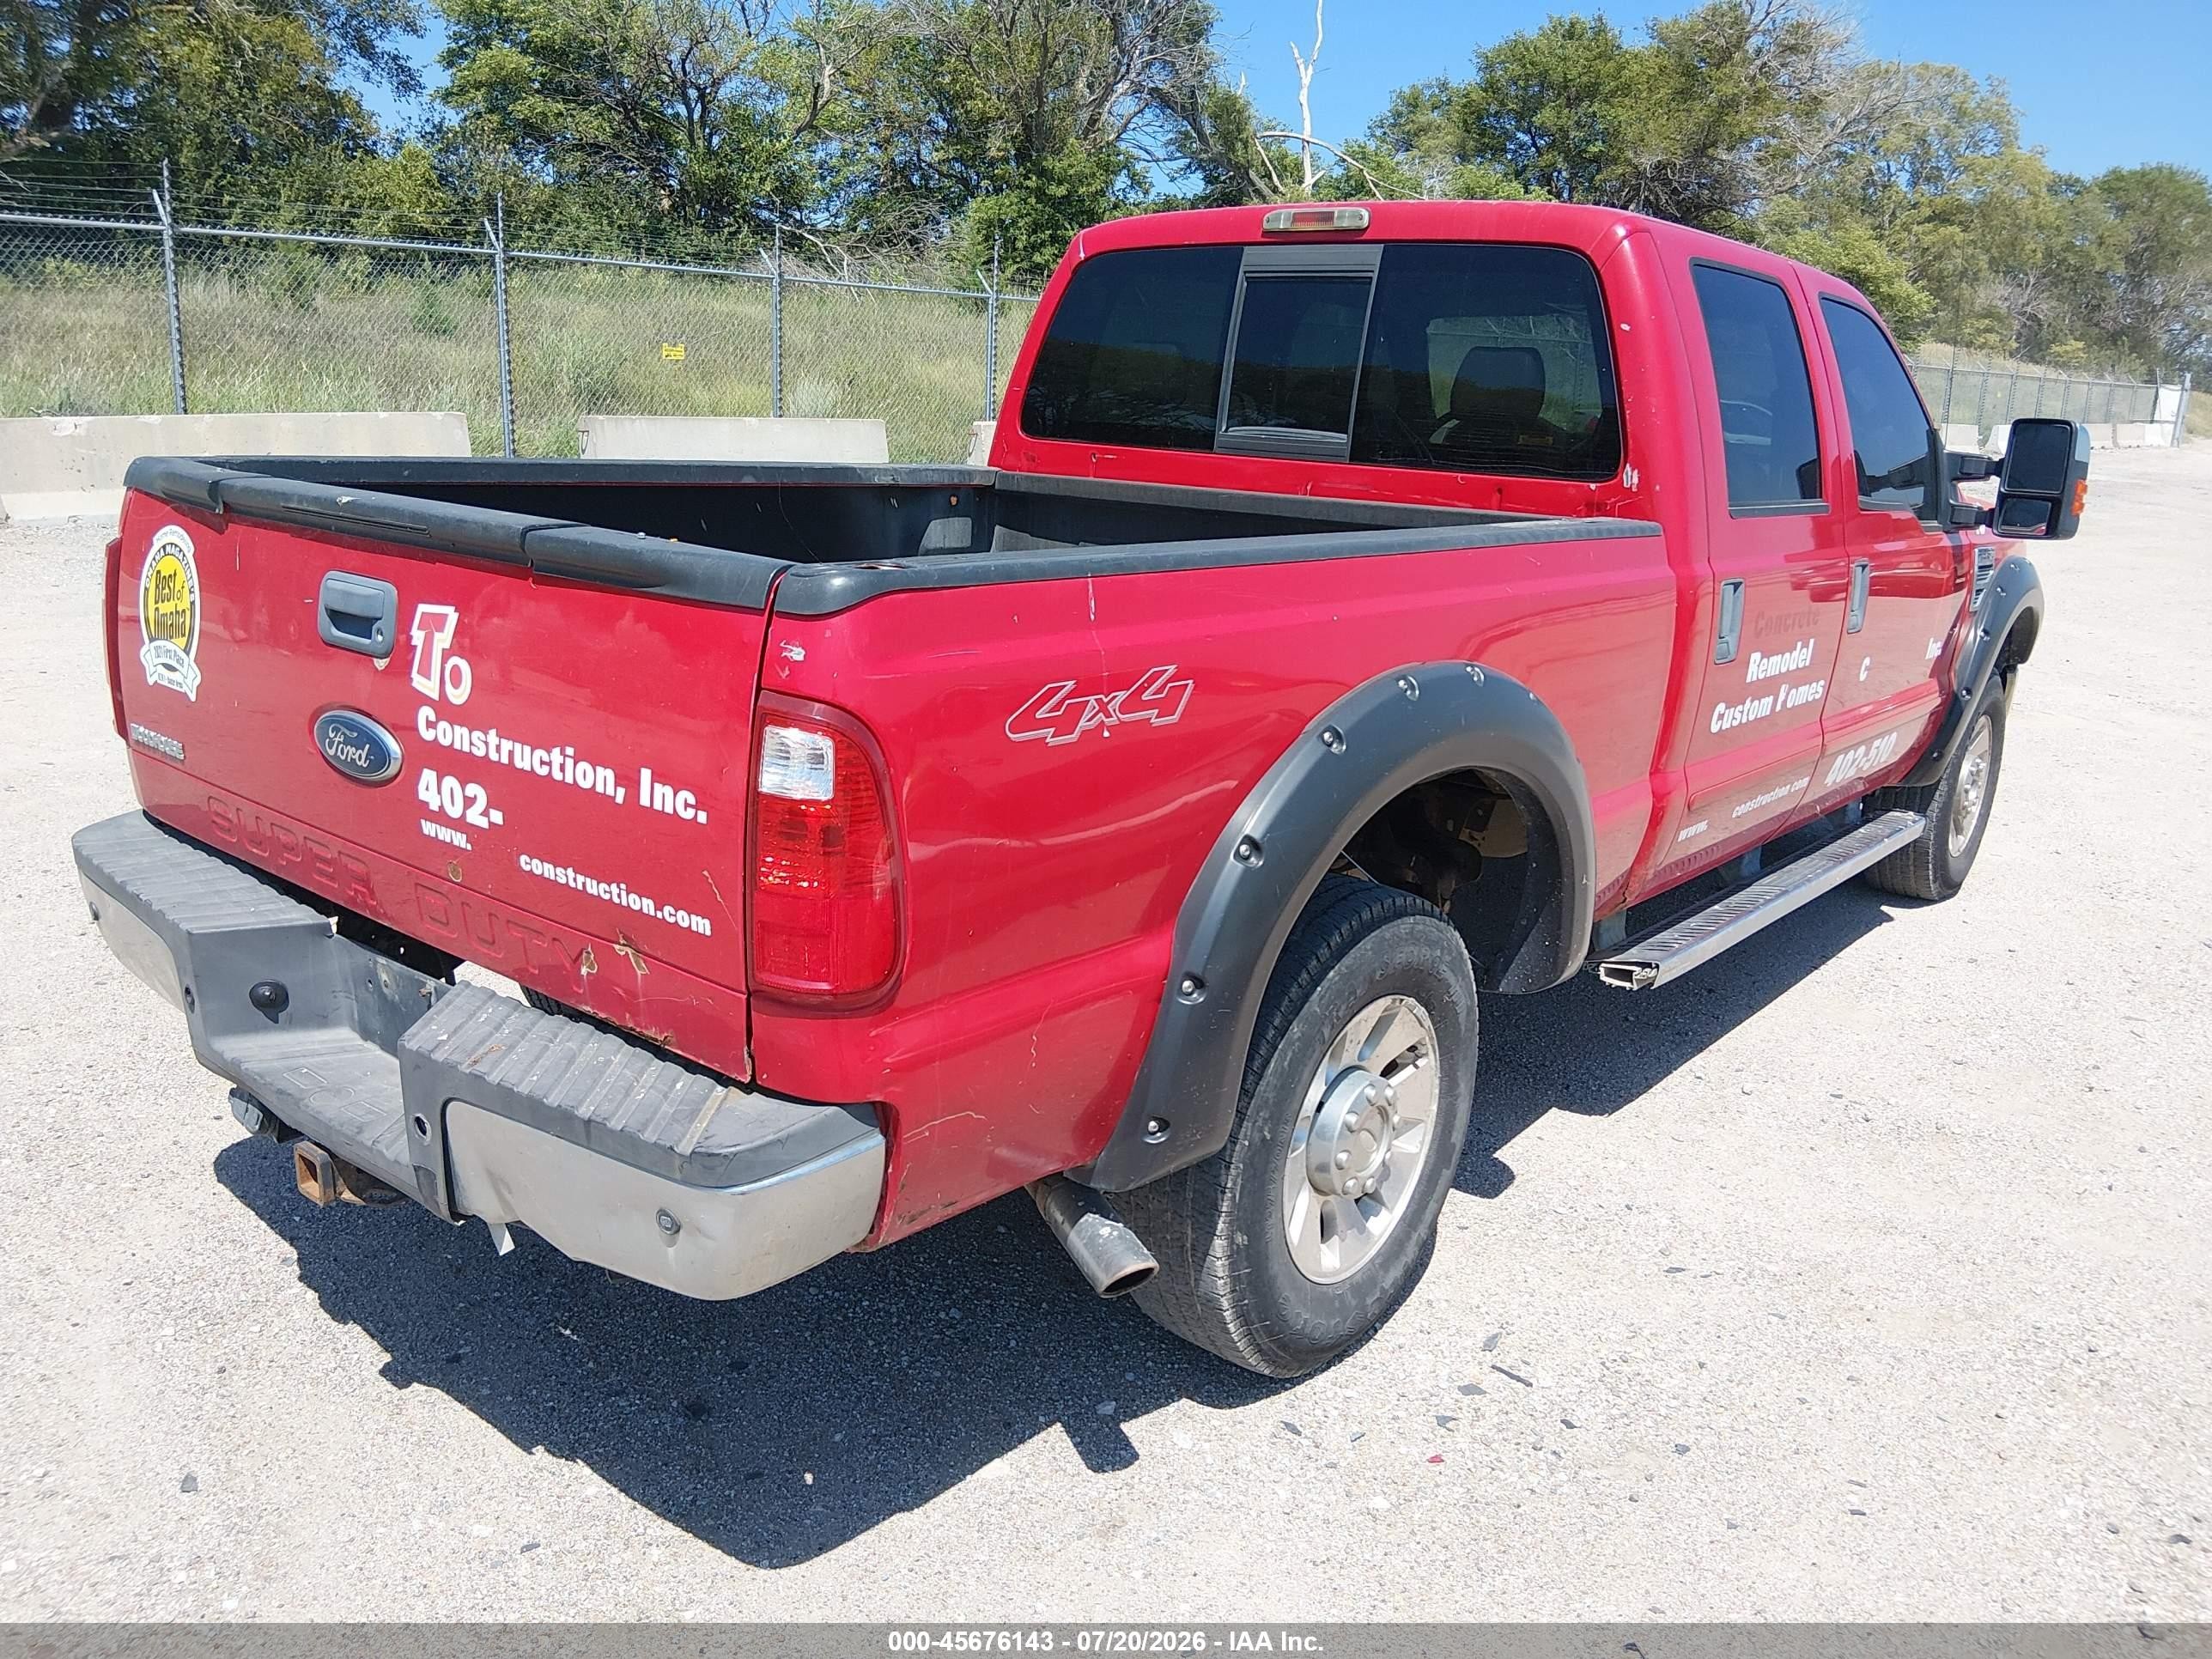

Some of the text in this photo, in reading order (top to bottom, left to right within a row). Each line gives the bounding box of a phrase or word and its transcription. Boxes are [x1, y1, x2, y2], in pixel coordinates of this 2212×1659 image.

[154, 568, 185, 605] Best of
[154, 603, 186, 640] Omaha
[1746, 638, 1814, 683] Remodel
[1859, 656, 1870, 682] C
[1006, 664, 1194, 746] 4x4
[1711, 694, 1774, 734] Custom
[325, 722, 370, 769] Ford
[417, 704, 708, 825] Construction, Inc.
[417, 767, 505, 830] 402-
[206, 795, 594, 994] SUPER DUTY
[419, 817, 713, 938] www. construction.com
